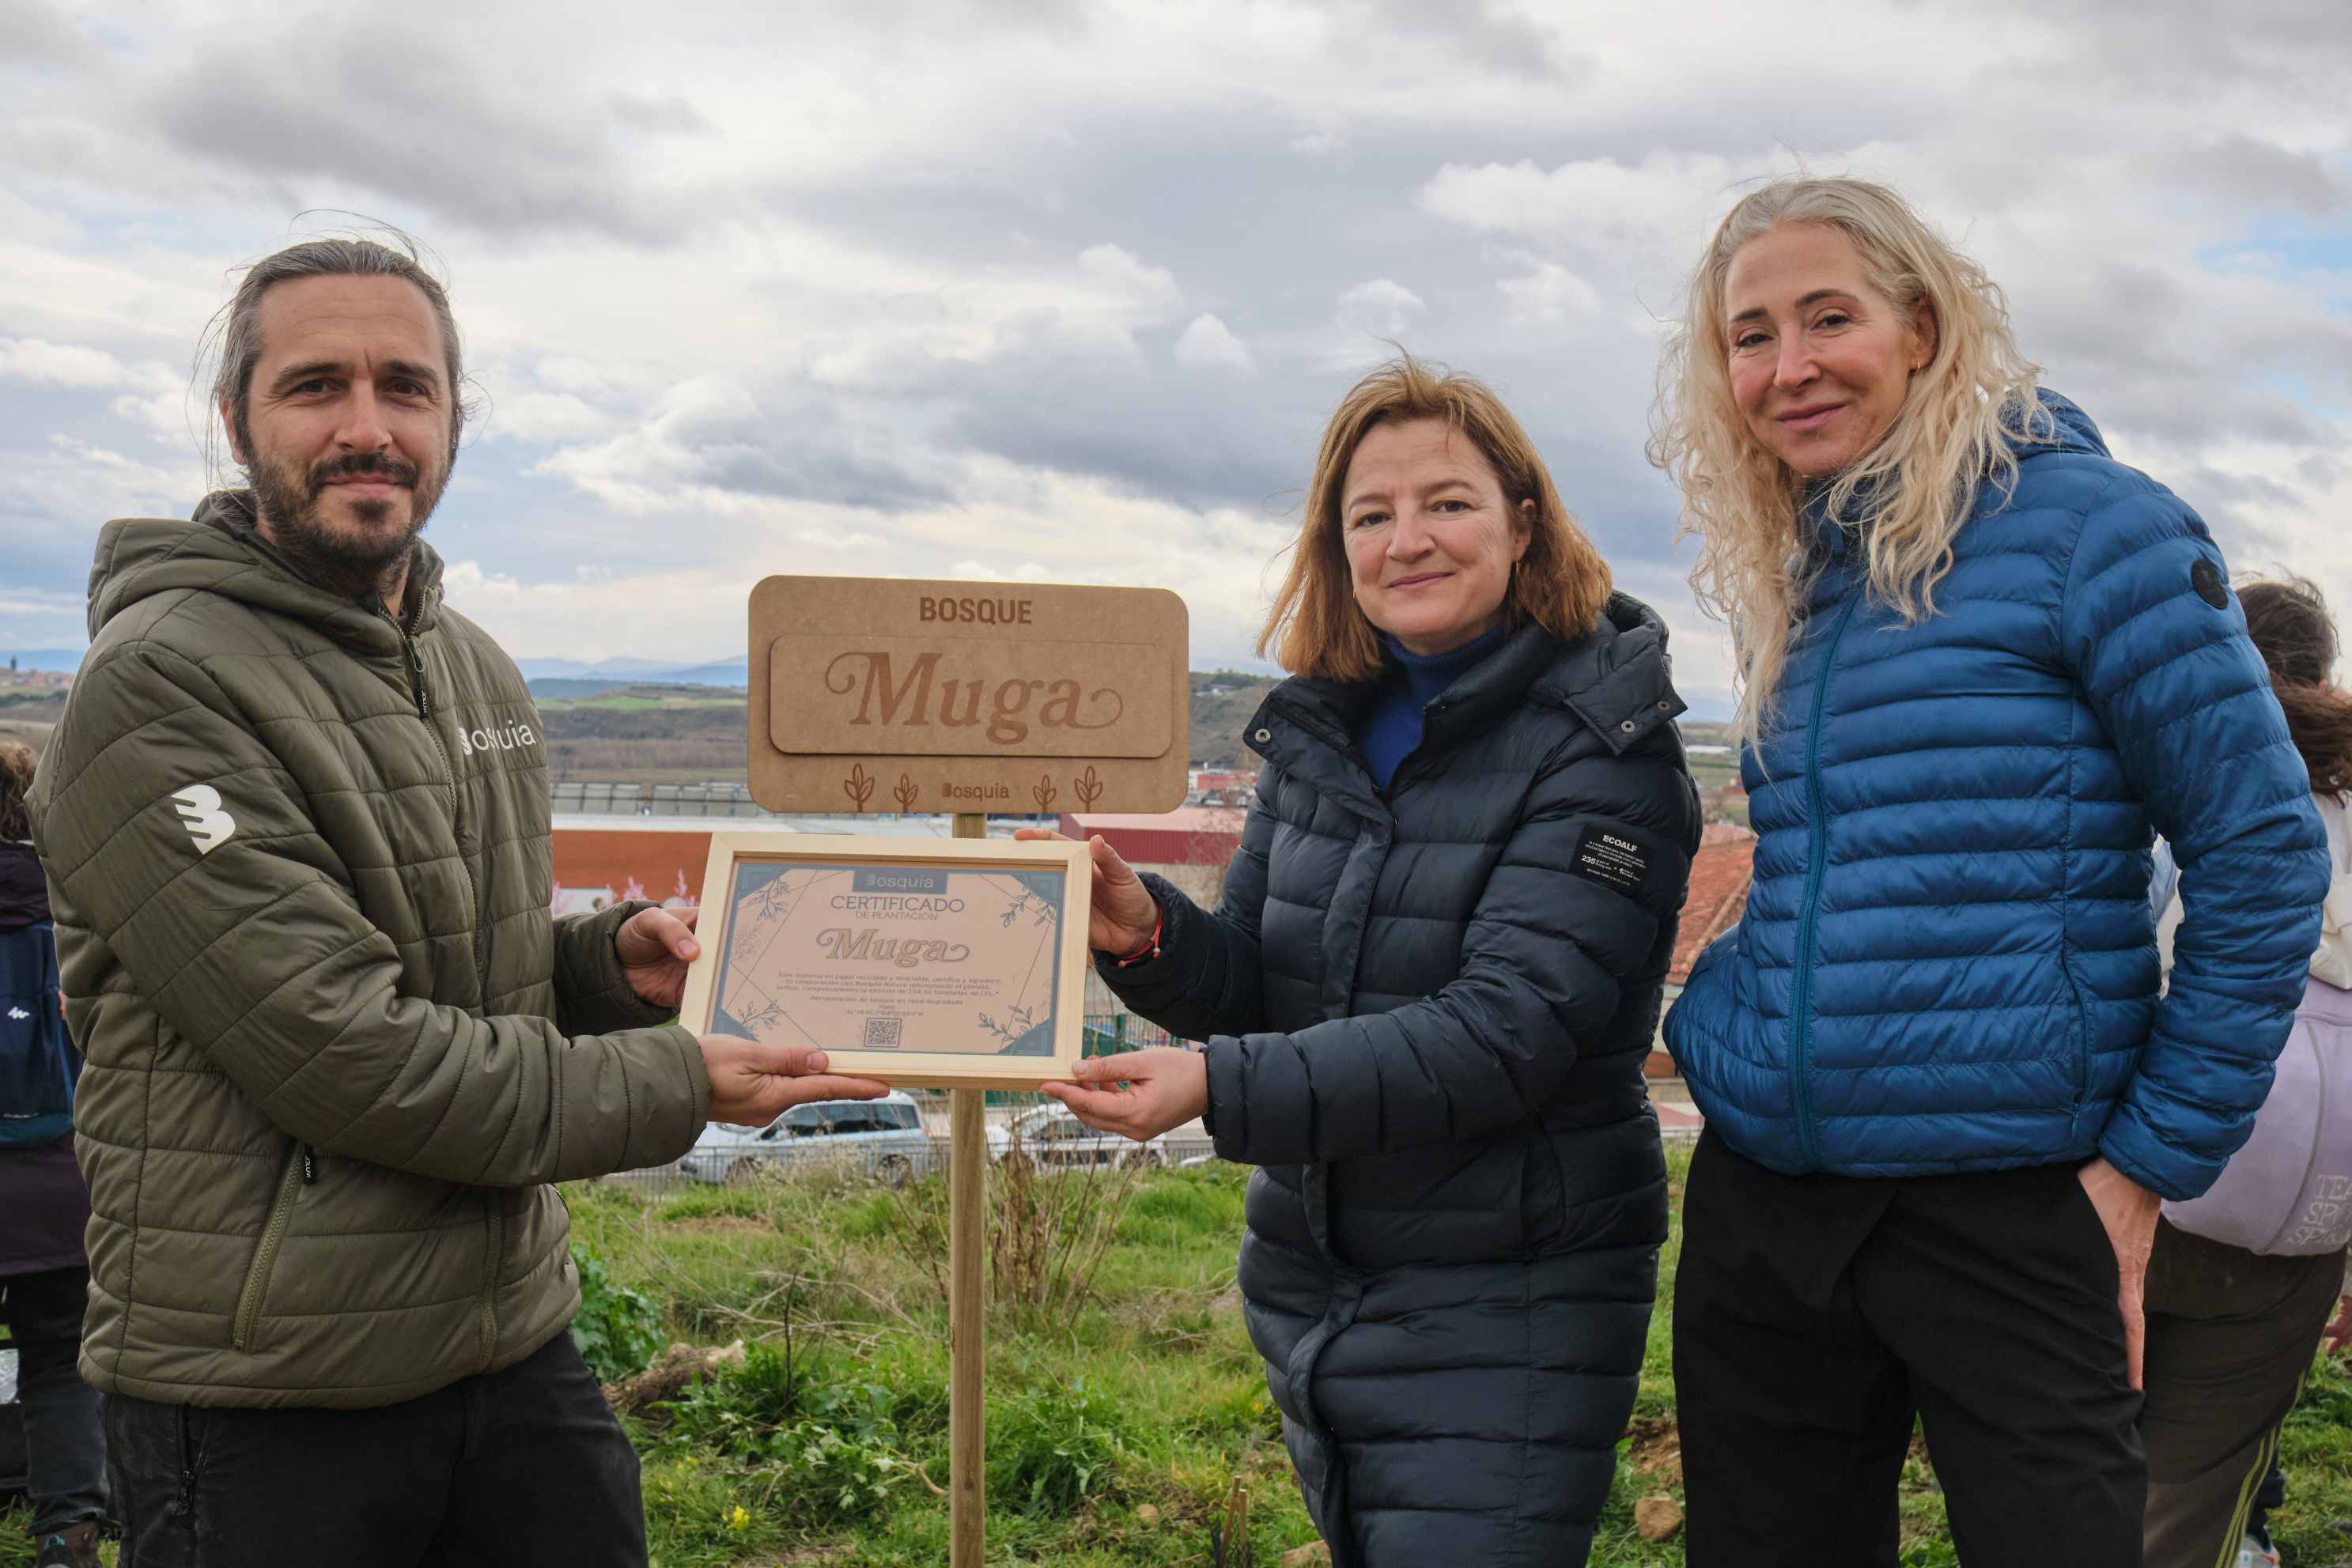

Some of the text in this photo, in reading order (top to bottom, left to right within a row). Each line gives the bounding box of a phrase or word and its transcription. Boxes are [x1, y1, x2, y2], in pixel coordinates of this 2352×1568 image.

[920, 597, 1032, 625] BOSQUE
[825, 651, 1124, 746] Muga
[942, 782, 1009, 803] Bosquia
[1602, 834, 1638, 852] ECOALF
[1582, 855, 1596, 864] 235
[866, 874, 935, 890] Bosquia
[830, 895, 965, 912] CERTIFICADO
[872, 911, 939, 921] PLANTACIÓN
[816, 928, 970, 968] Muga
